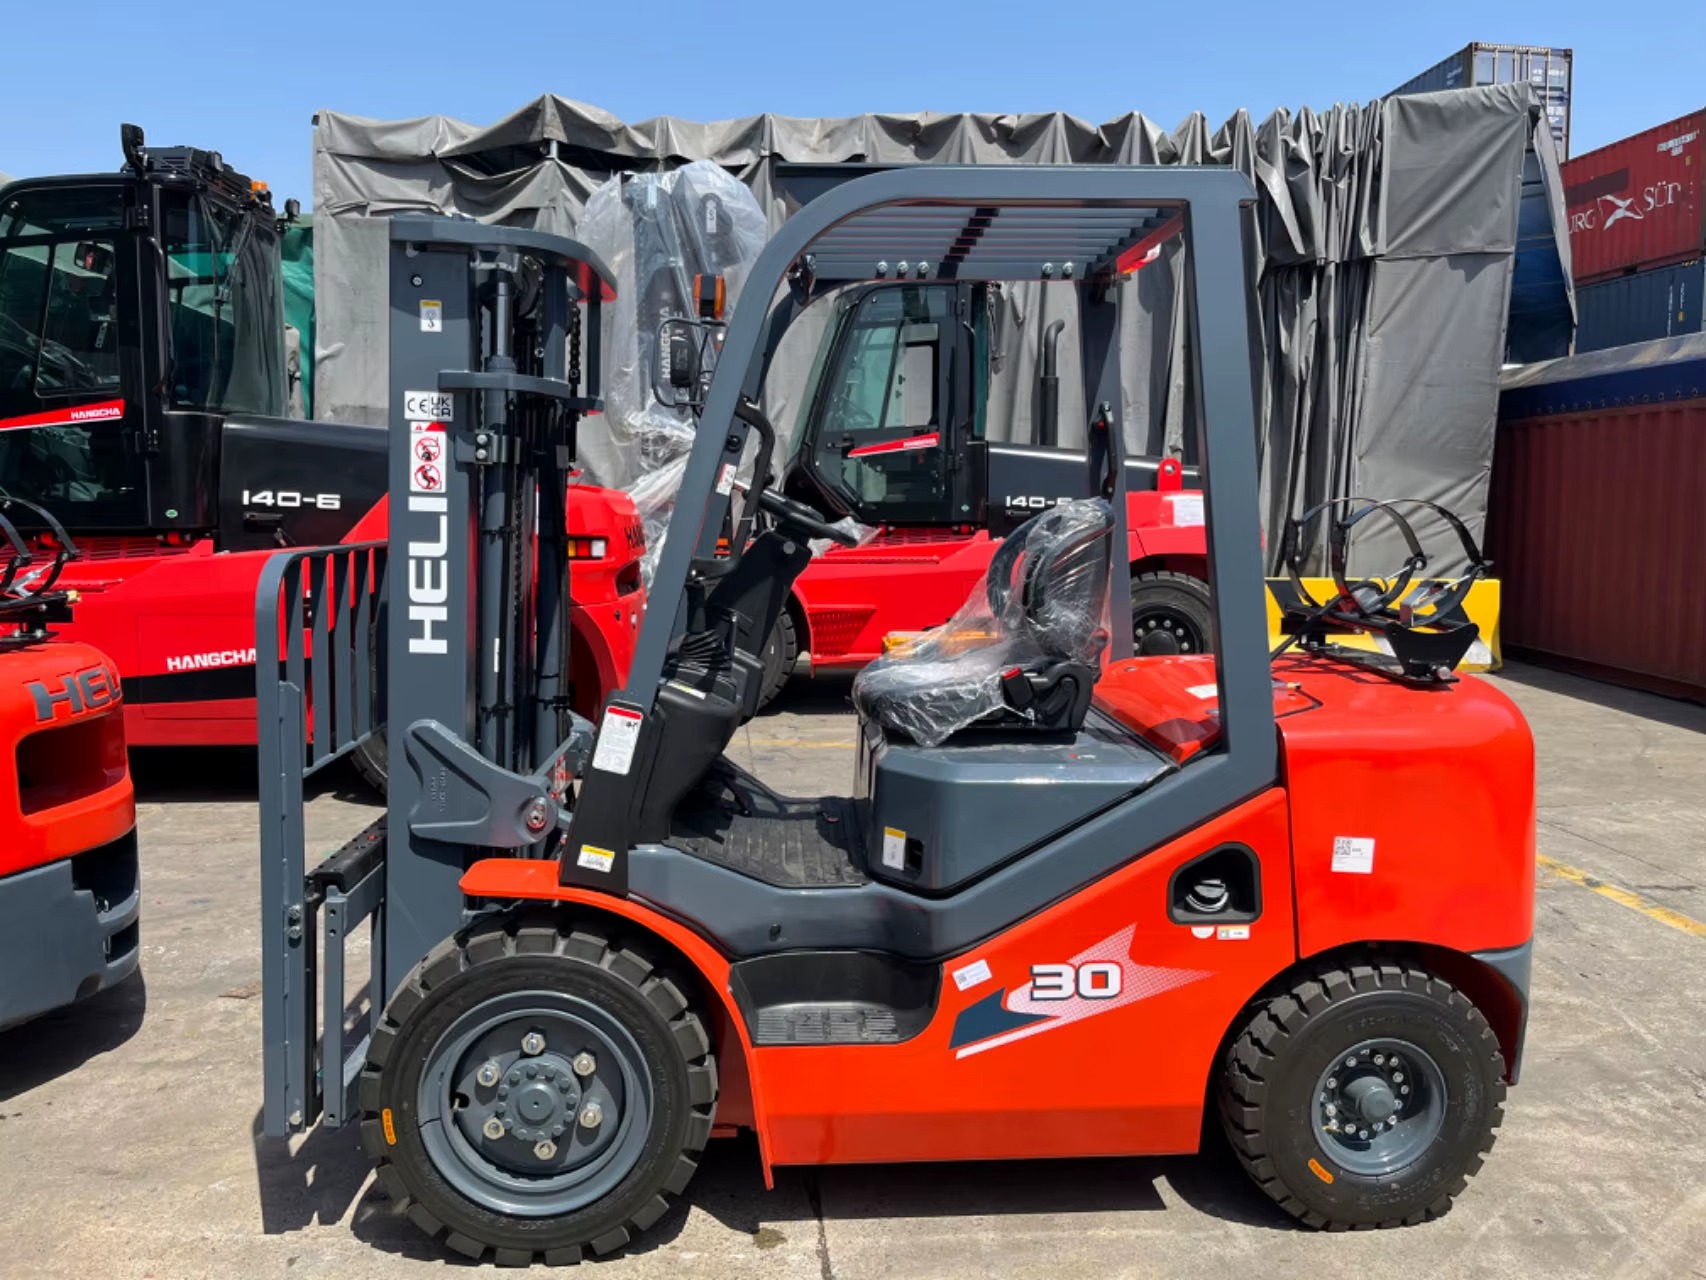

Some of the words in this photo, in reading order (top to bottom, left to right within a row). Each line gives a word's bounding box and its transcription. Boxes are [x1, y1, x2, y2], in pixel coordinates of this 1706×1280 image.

[70, 407, 121, 420] HANGCHA
[242, 488, 342, 510] 140-6
[408, 496, 448, 654] HELI
[166, 647, 257, 671] HANGCHA
[1030, 961, 1123, 1001] 30
